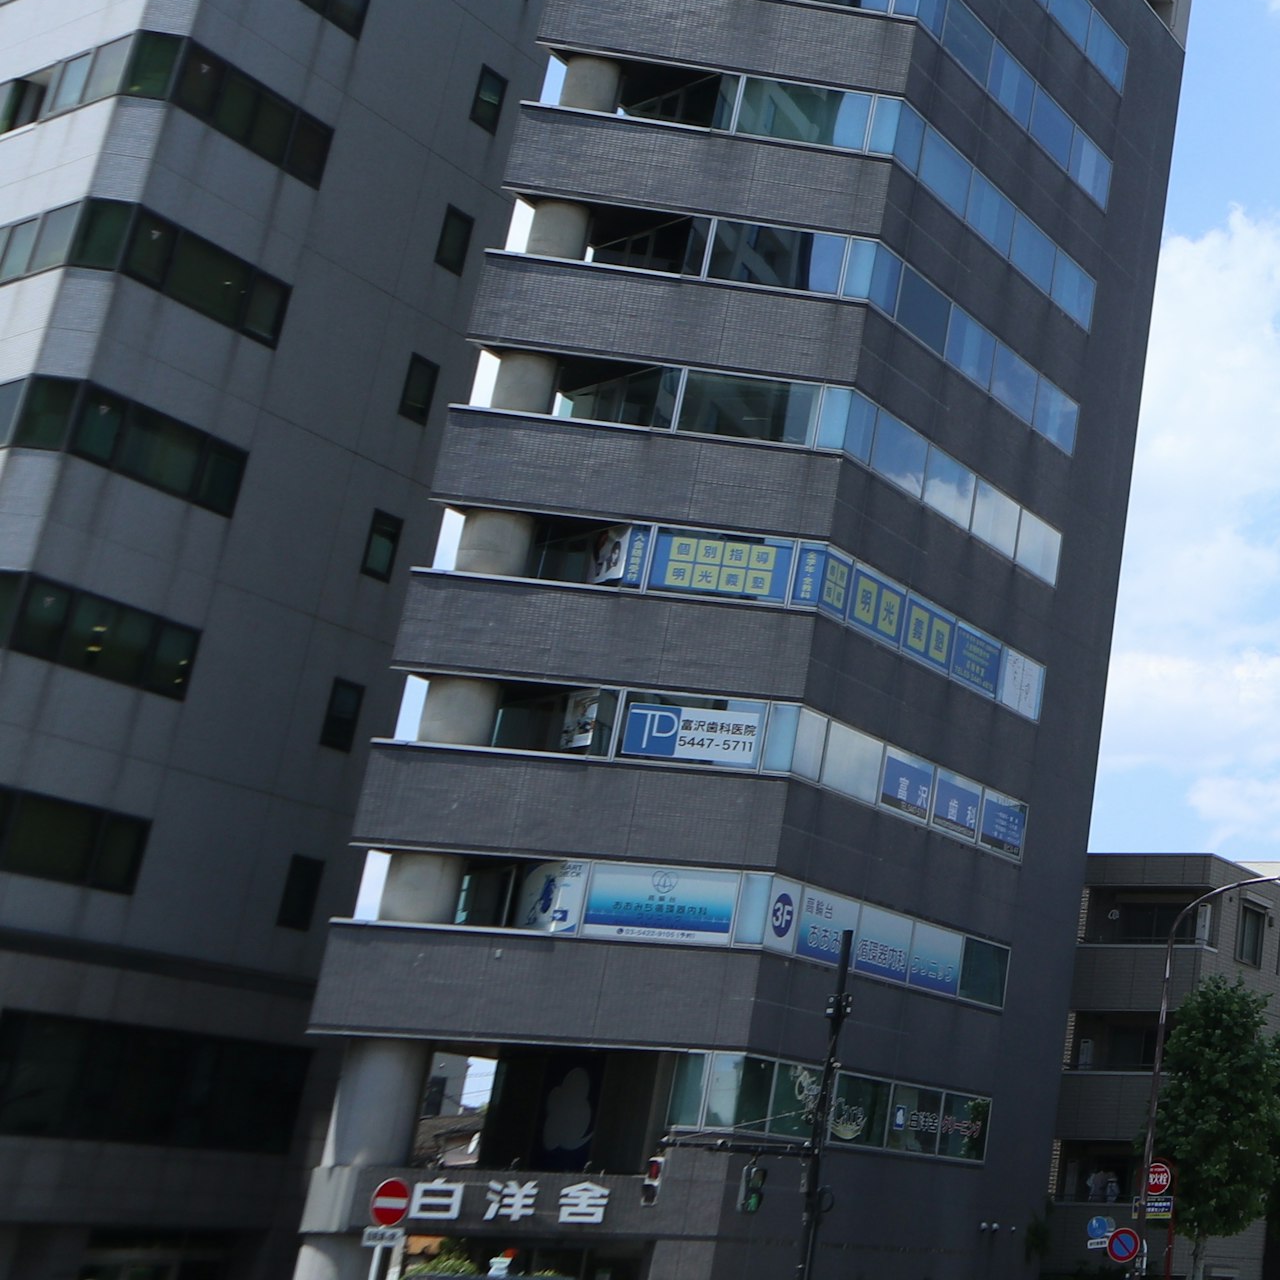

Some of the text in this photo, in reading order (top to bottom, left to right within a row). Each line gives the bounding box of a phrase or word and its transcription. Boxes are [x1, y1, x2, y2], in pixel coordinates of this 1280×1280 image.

[672, 567, 765, 590] 明光義塾
[681, 720, 757, 736] 富沢歯科医院
[678, 736, 754, 753] 5447-5711
[772, 902, 793, 929] 3F
